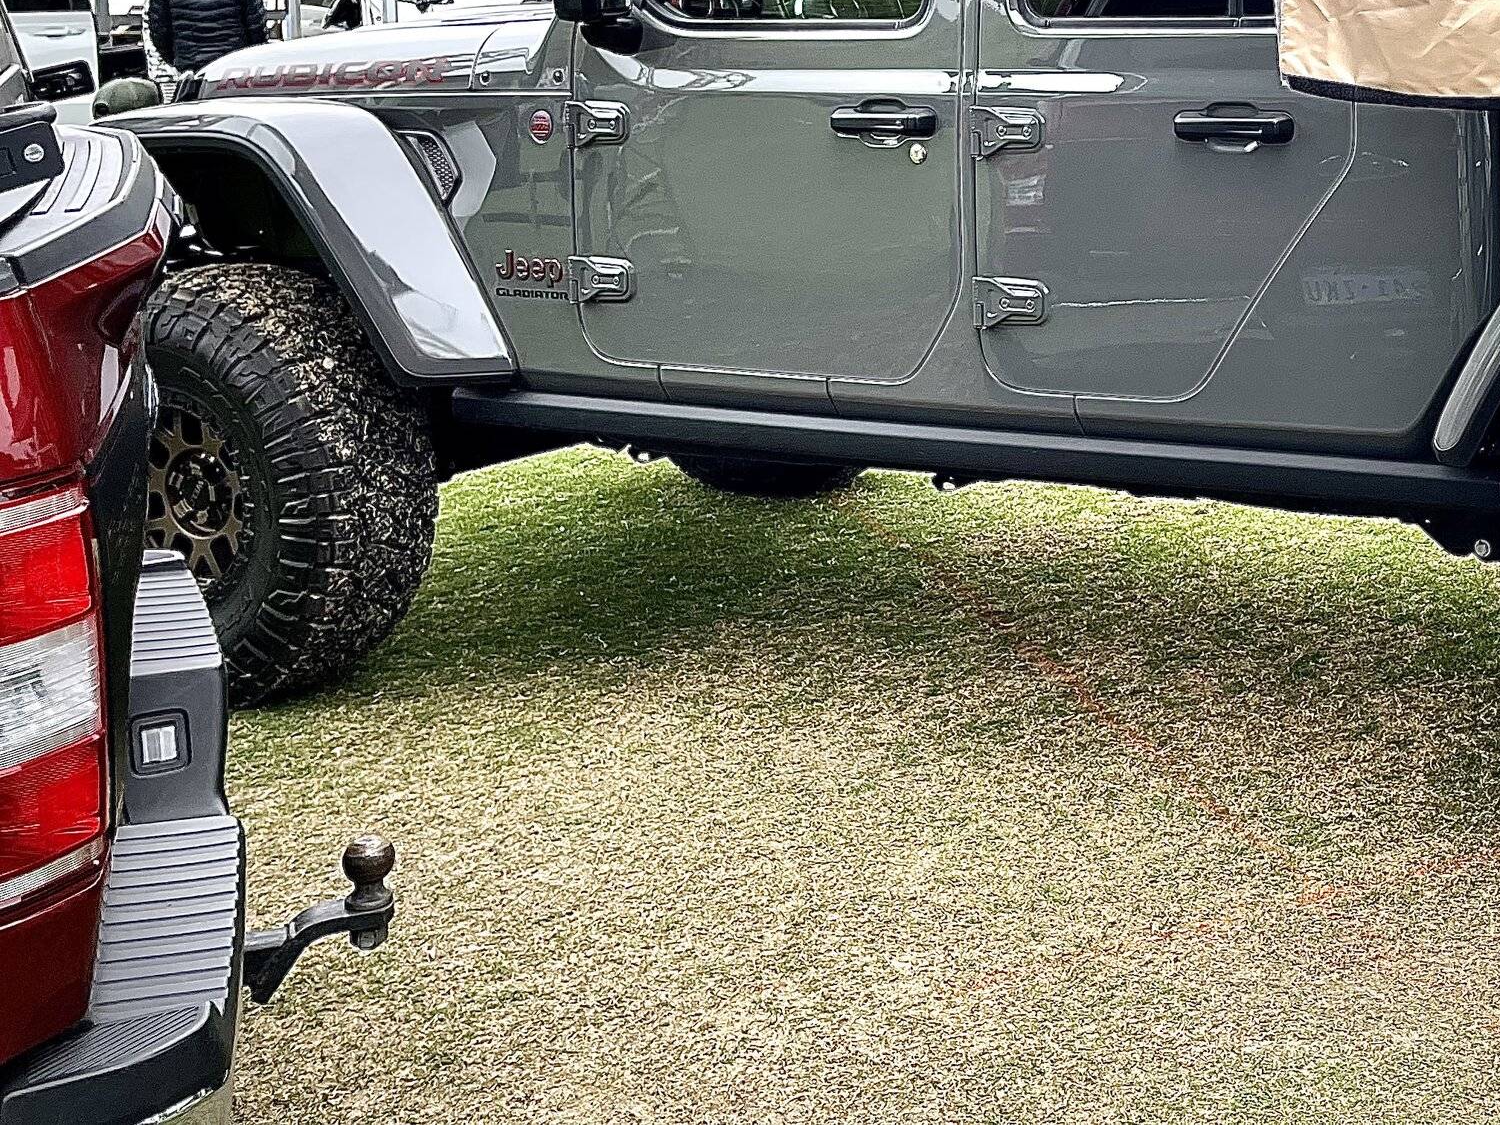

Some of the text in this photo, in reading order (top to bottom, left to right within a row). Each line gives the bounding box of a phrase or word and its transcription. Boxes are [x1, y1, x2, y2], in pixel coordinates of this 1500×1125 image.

[216, 57, 453, 90] RUBICON
[495, 249, 564, 289] Jeep
[495, 287, 569, 301] GLADIATOR
